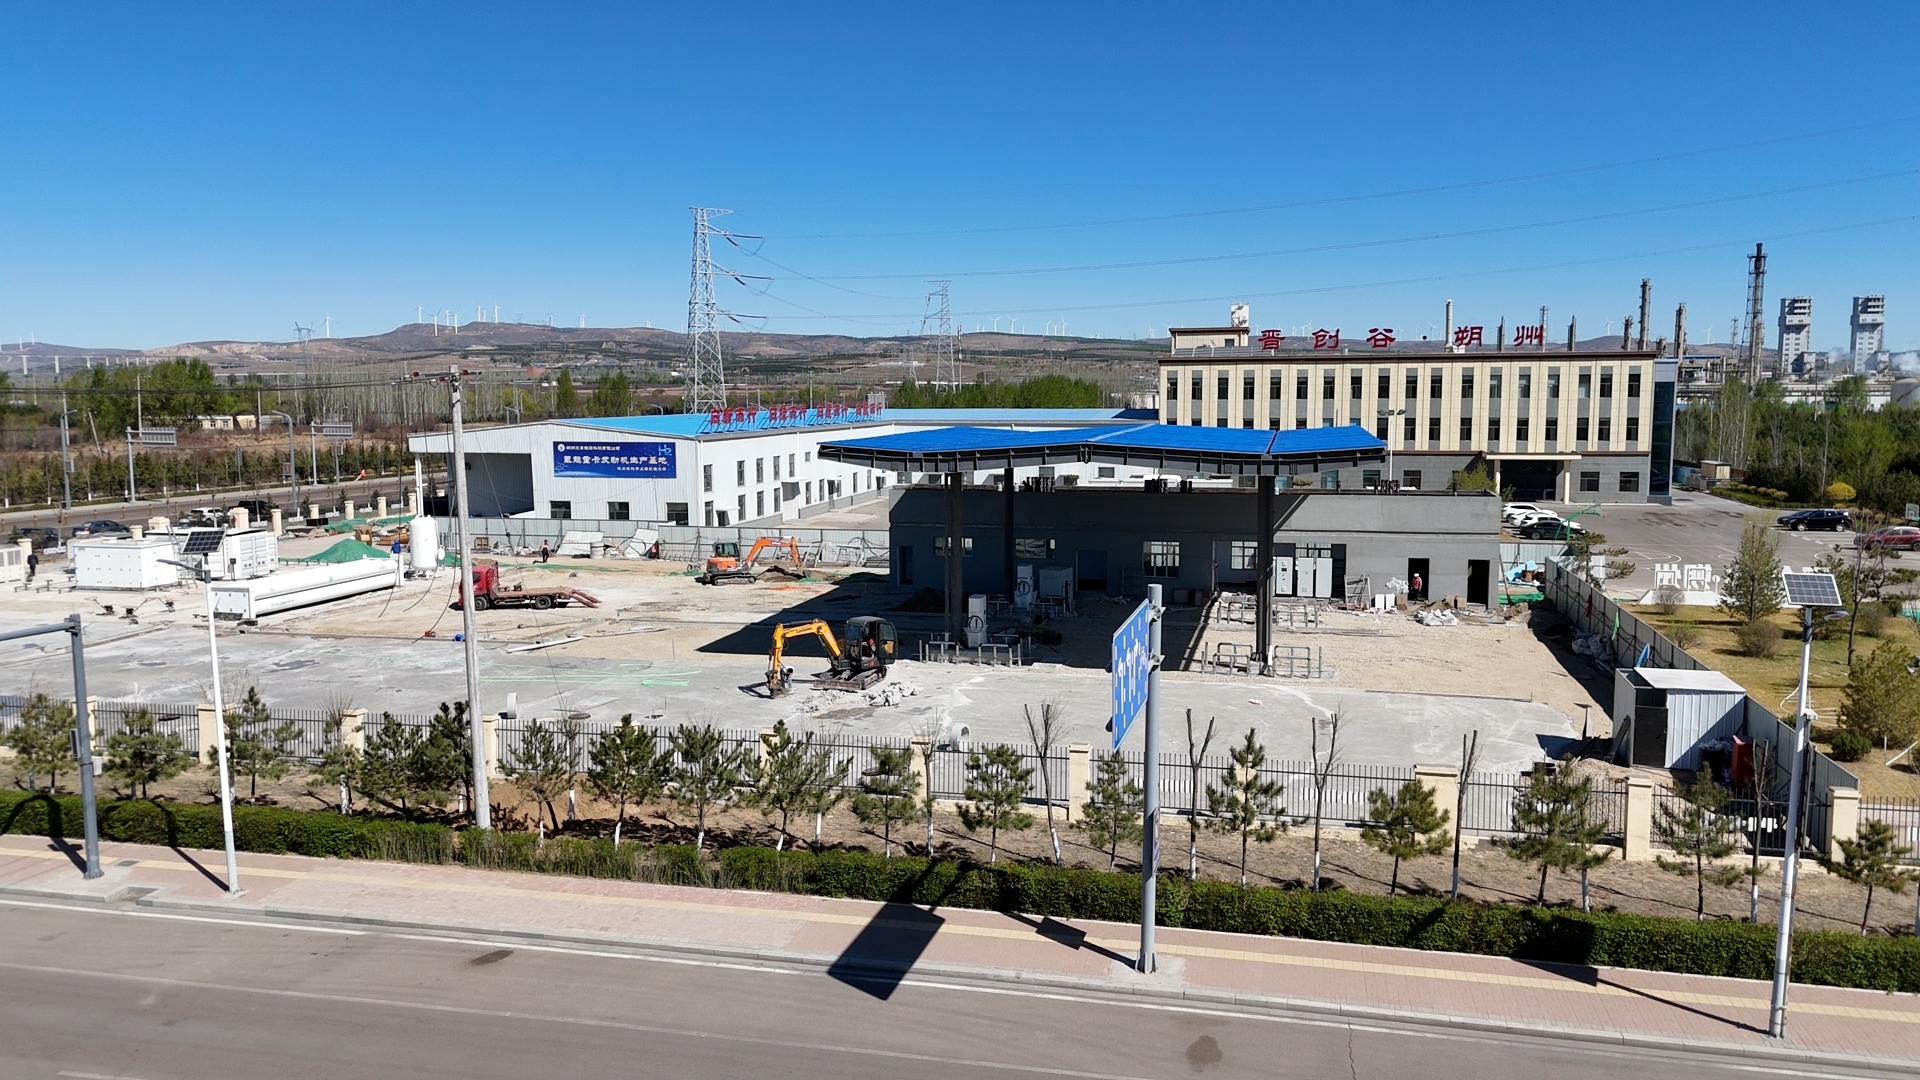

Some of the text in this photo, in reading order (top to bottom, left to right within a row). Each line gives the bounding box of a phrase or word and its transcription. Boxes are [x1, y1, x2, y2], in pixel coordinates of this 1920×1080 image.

[1259, 326, 1545, 350] 晋创谷·朔州
[562, 455, 668, 465] 氢能重卡发动机生产基地
